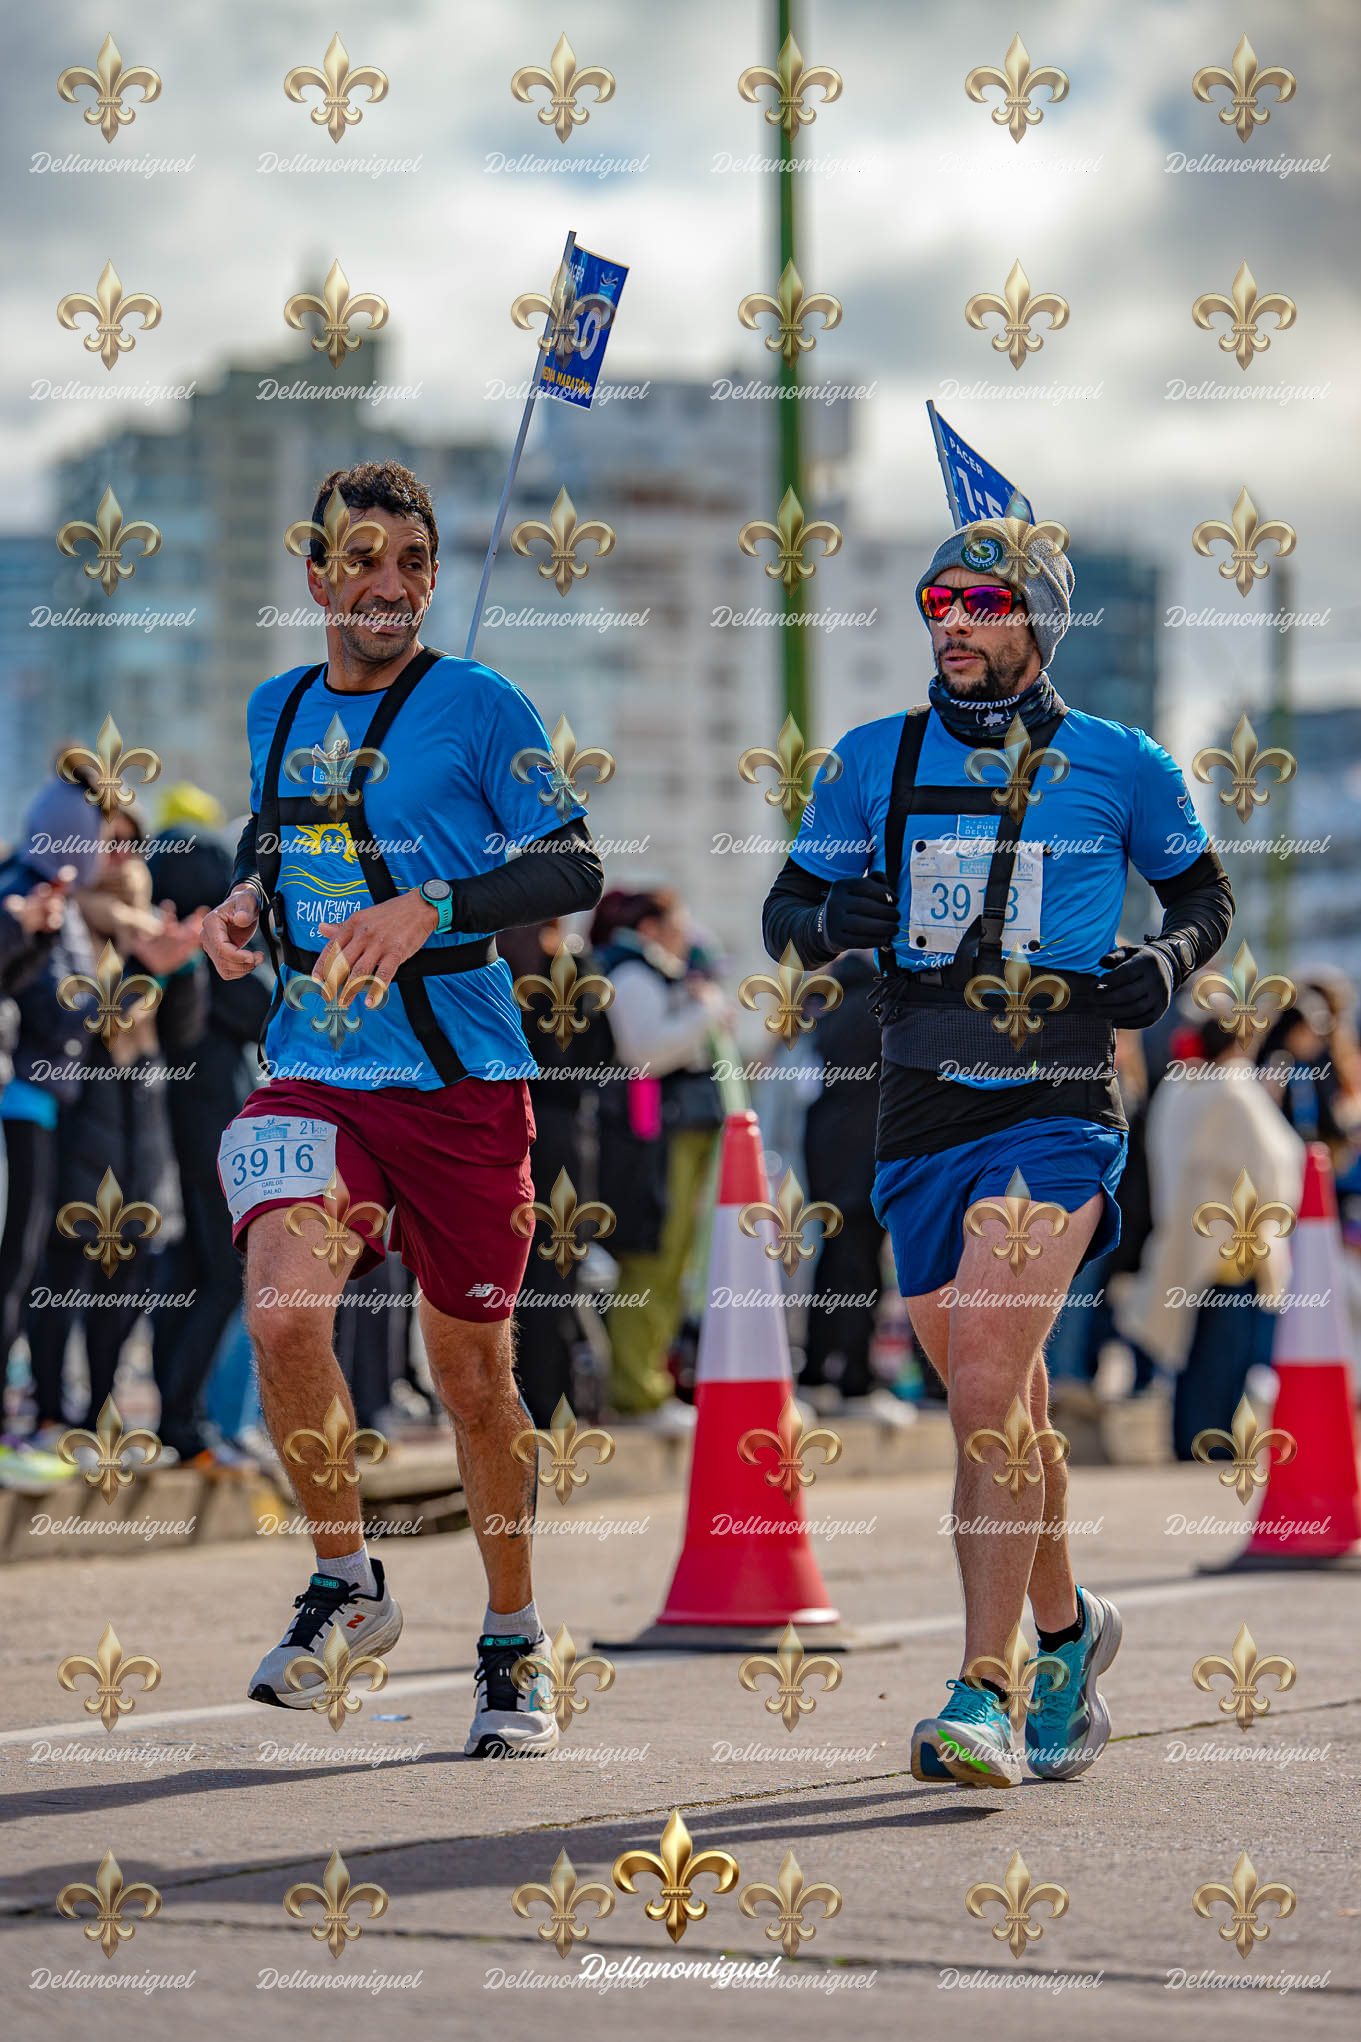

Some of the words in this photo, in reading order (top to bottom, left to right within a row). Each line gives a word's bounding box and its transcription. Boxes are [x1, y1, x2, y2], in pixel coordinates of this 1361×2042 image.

[569, 262, 585, 283] ACER
[949, 436, 984, 478] PACER
[297, 900, 328, 922] RUN
[328, 900, 360, 914] PUNTA
[930, 882, 1019, 923] 393
[232, 1143, 314, 1187] 3916
[262, 1180, 284, 1188] CARLOS
